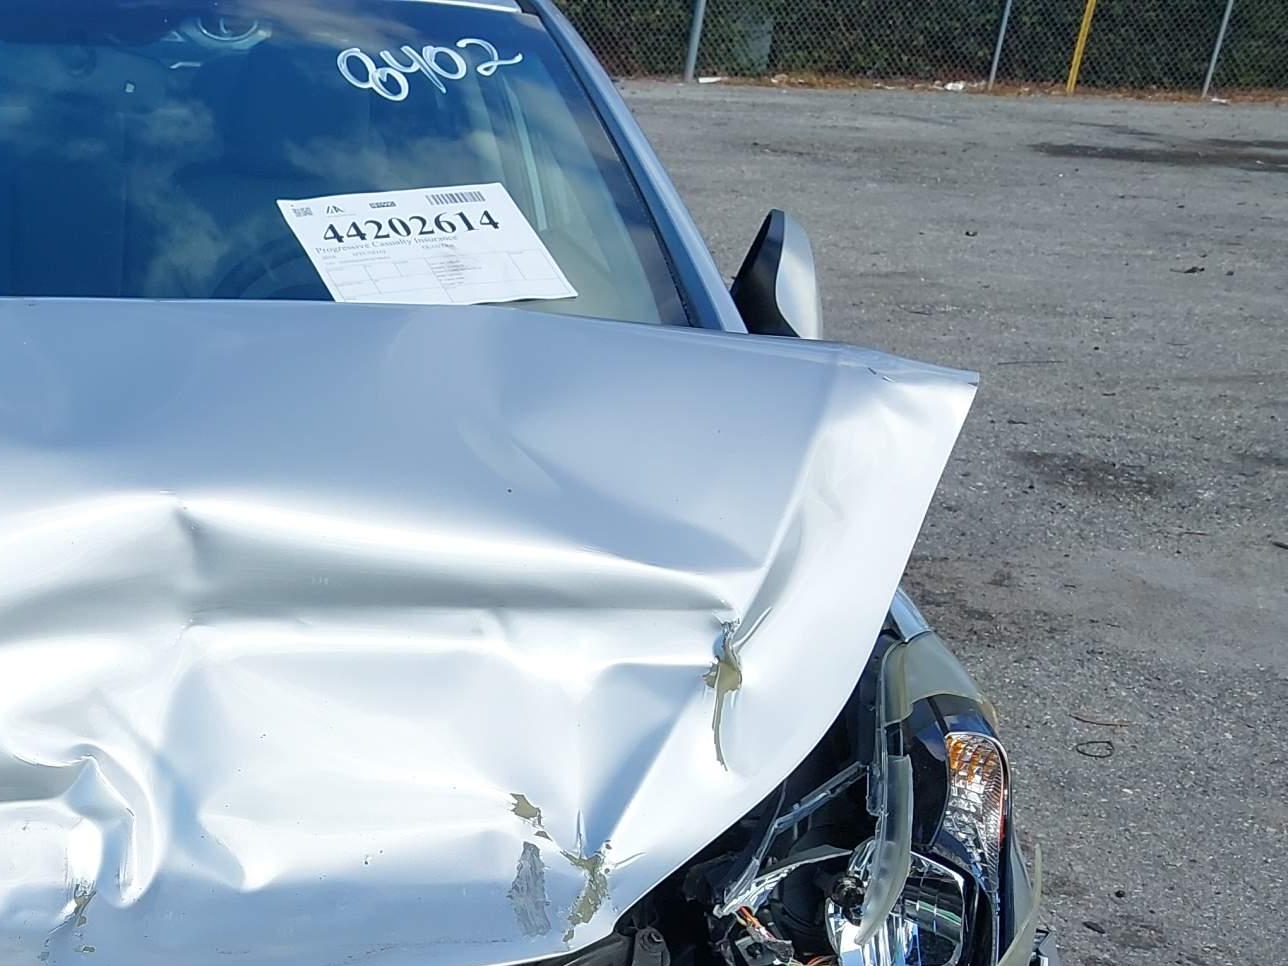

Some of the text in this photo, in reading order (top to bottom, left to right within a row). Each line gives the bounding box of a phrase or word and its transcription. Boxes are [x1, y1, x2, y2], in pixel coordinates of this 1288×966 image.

[336, 38, 523, 102] 8402
[323, 210, 499, 243] 44202614
[315, 243, 370, 254] Progressive
[372, 239, 412, 247] Casualty
[414, 235, 458, 244] Insurance
